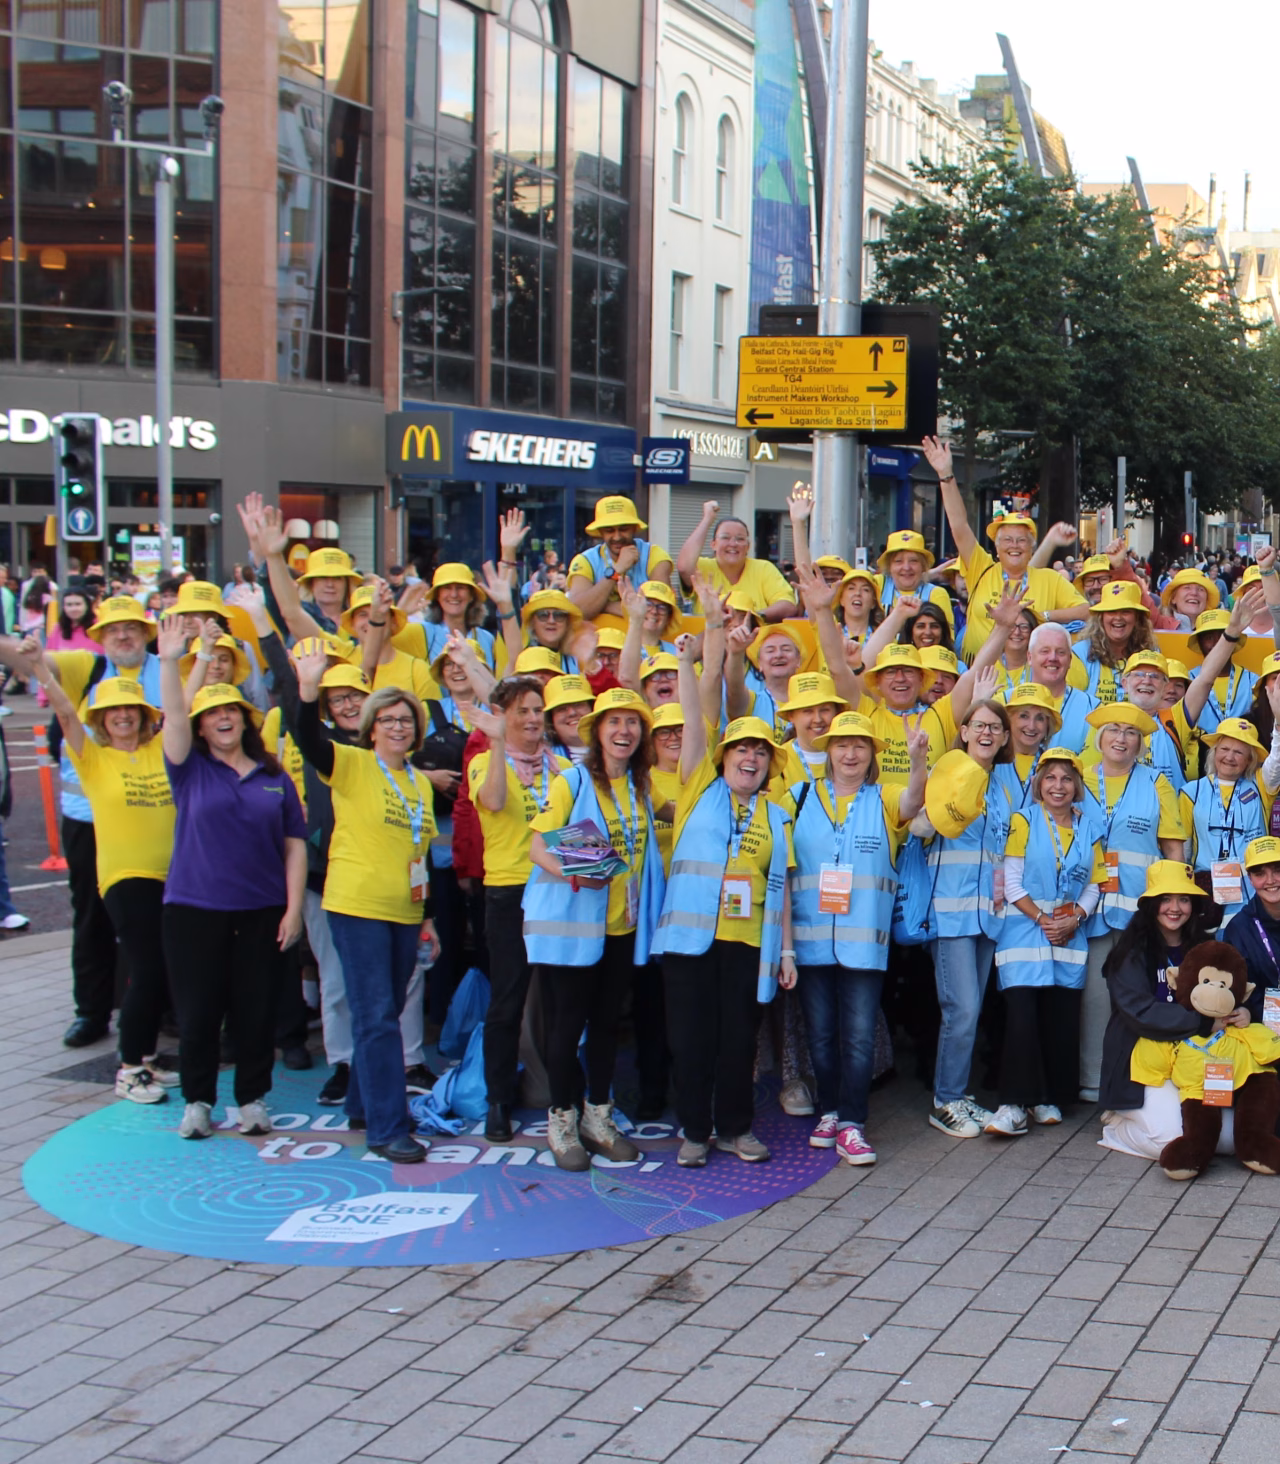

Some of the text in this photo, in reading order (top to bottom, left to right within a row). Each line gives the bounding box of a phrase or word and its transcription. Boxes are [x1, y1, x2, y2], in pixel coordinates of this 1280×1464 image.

[777, 348, 790, 356] City
[784, 375, 802, 383] TG4
[747, 394, 859, 403] Instrument Makers Workshop
[815, 407, 830, 415] Bus
[790, 417, 833, 426] Laganside
[836, 417, 853, 425] Bus
[469, 430, 597, 469] SKECHERS
[753, 441, 774, 460] A
[257, 1136, 343, 1160] to
[320, 1203, 452, 1216] Belfast
[309, 1213, 396, 1225] ONE
